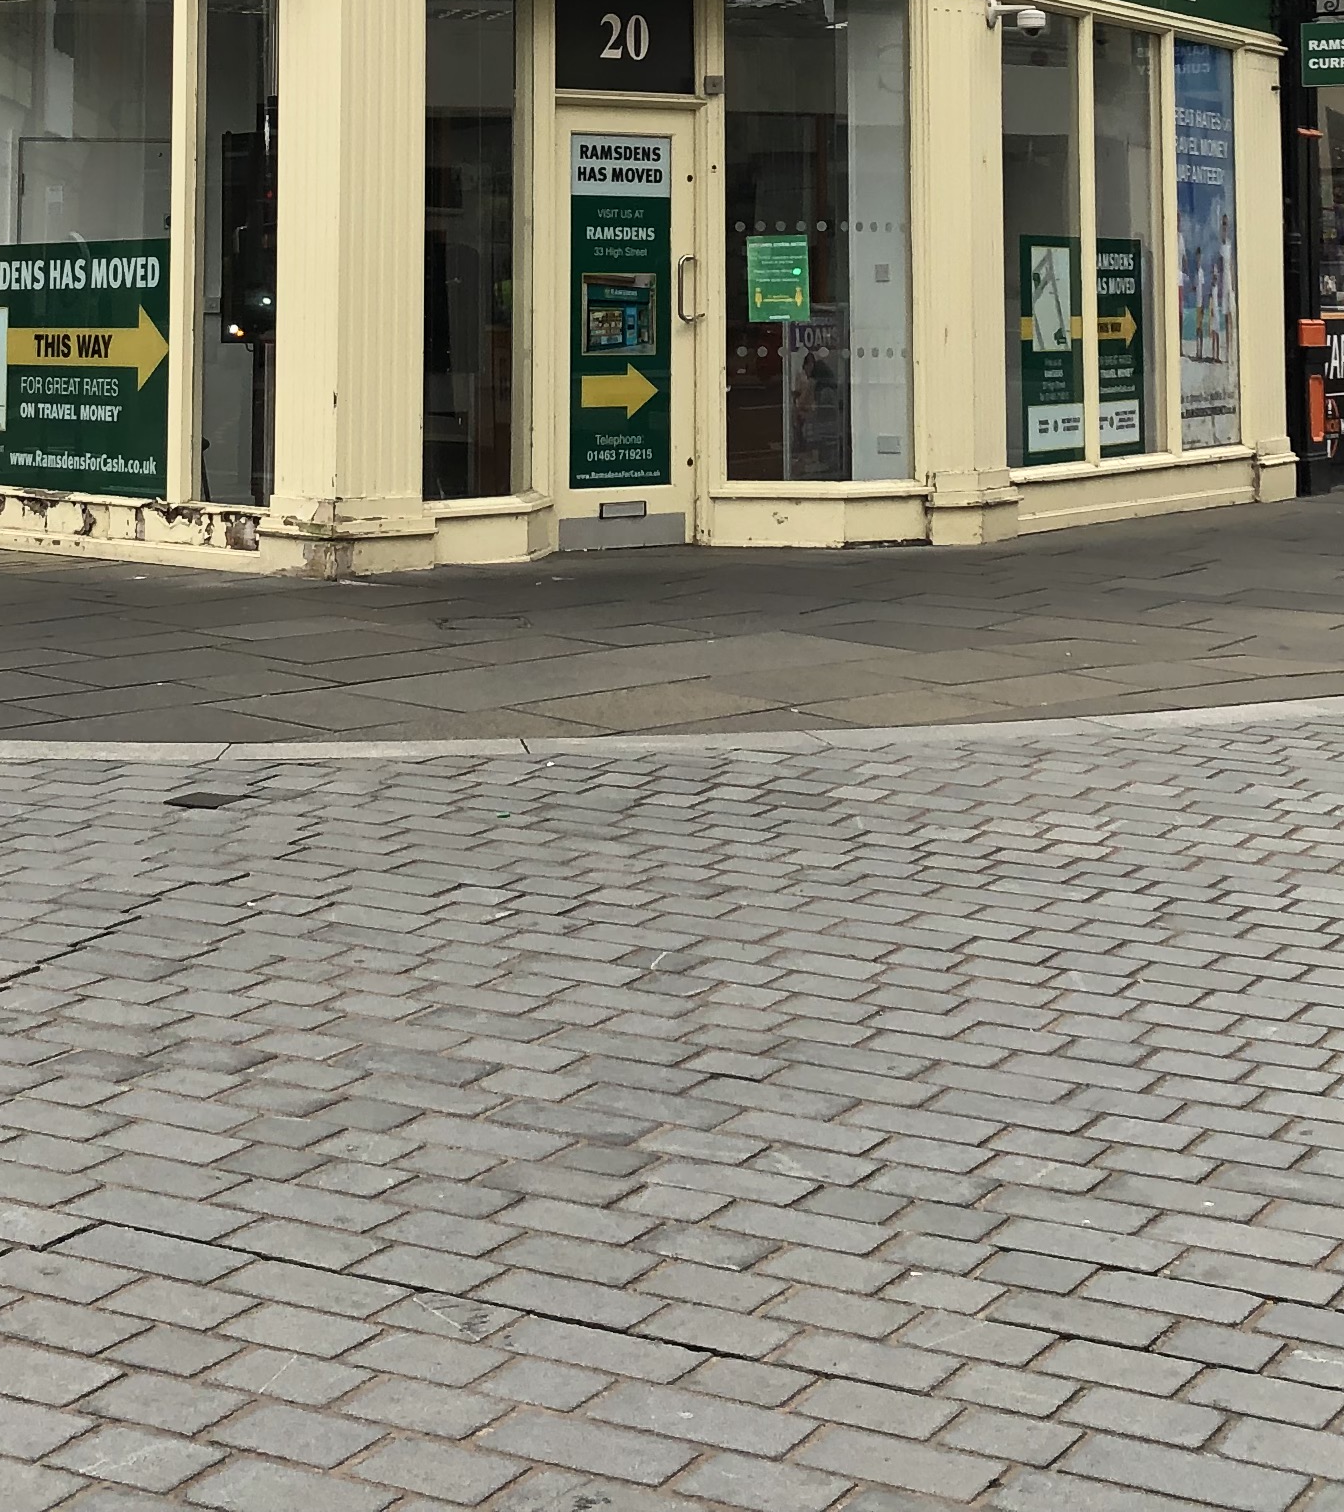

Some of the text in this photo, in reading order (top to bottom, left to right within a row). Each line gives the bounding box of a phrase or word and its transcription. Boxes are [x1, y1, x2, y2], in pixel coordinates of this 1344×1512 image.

[599, 13, 651, 61] 20
[579, 144, 662, 163] RAMSDENS
[577, 166, 663, 184] HAS MOVED
[597, 208, 645, 219] VISIT US AT
[586, 226, 656, 241] RAMSDENS
[593, 246, 648, 259] 33 High Street
[1096, 252, 1135, 271] AMSDENS
[49, 259, 87, 290] HAS
[91, 256, 160, 289] MOVED
[1096, 279, 1106, 295] AS
[34, 333, 113, 359] THIS WAY
[20, 376, 119, 397] FOR GREAT RATES
[19, 402, 35, 419] ON
[37, 402, 77, 420] TRAVEL
[594, 434, 645, 448] Telephone:
[9, 449, 157, 475] www.RamsdensForCash.co.uk
[587, 449, 653, 462] 01463 719215
